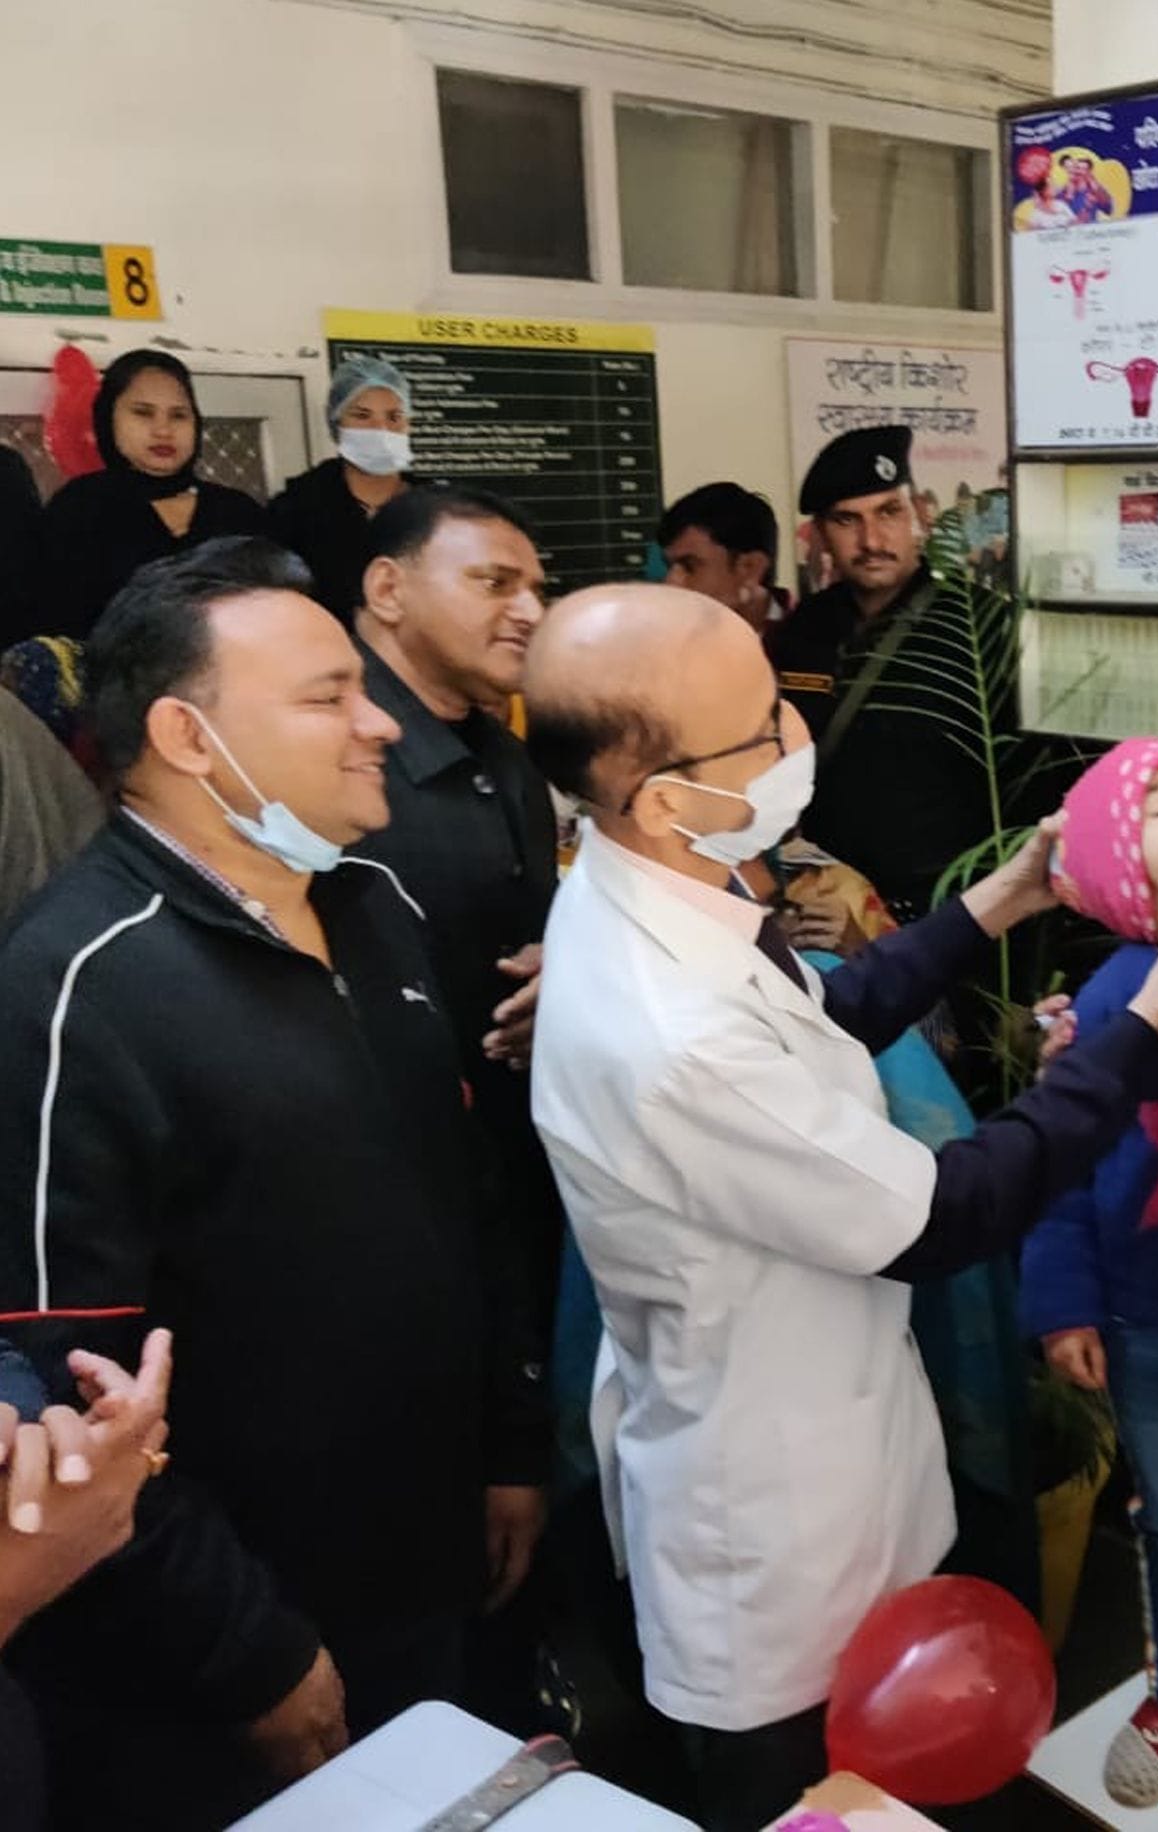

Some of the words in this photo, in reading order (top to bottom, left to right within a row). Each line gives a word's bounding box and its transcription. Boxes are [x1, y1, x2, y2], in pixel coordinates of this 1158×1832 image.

[123, 257, 149, 307] 8
[417, 320, 475, 339] USER
[481, 323, 579, 344] CHARGES
[826, 348, 897, 395] राष्ट्रीय
[901, 350, 970, 395] किशोर
